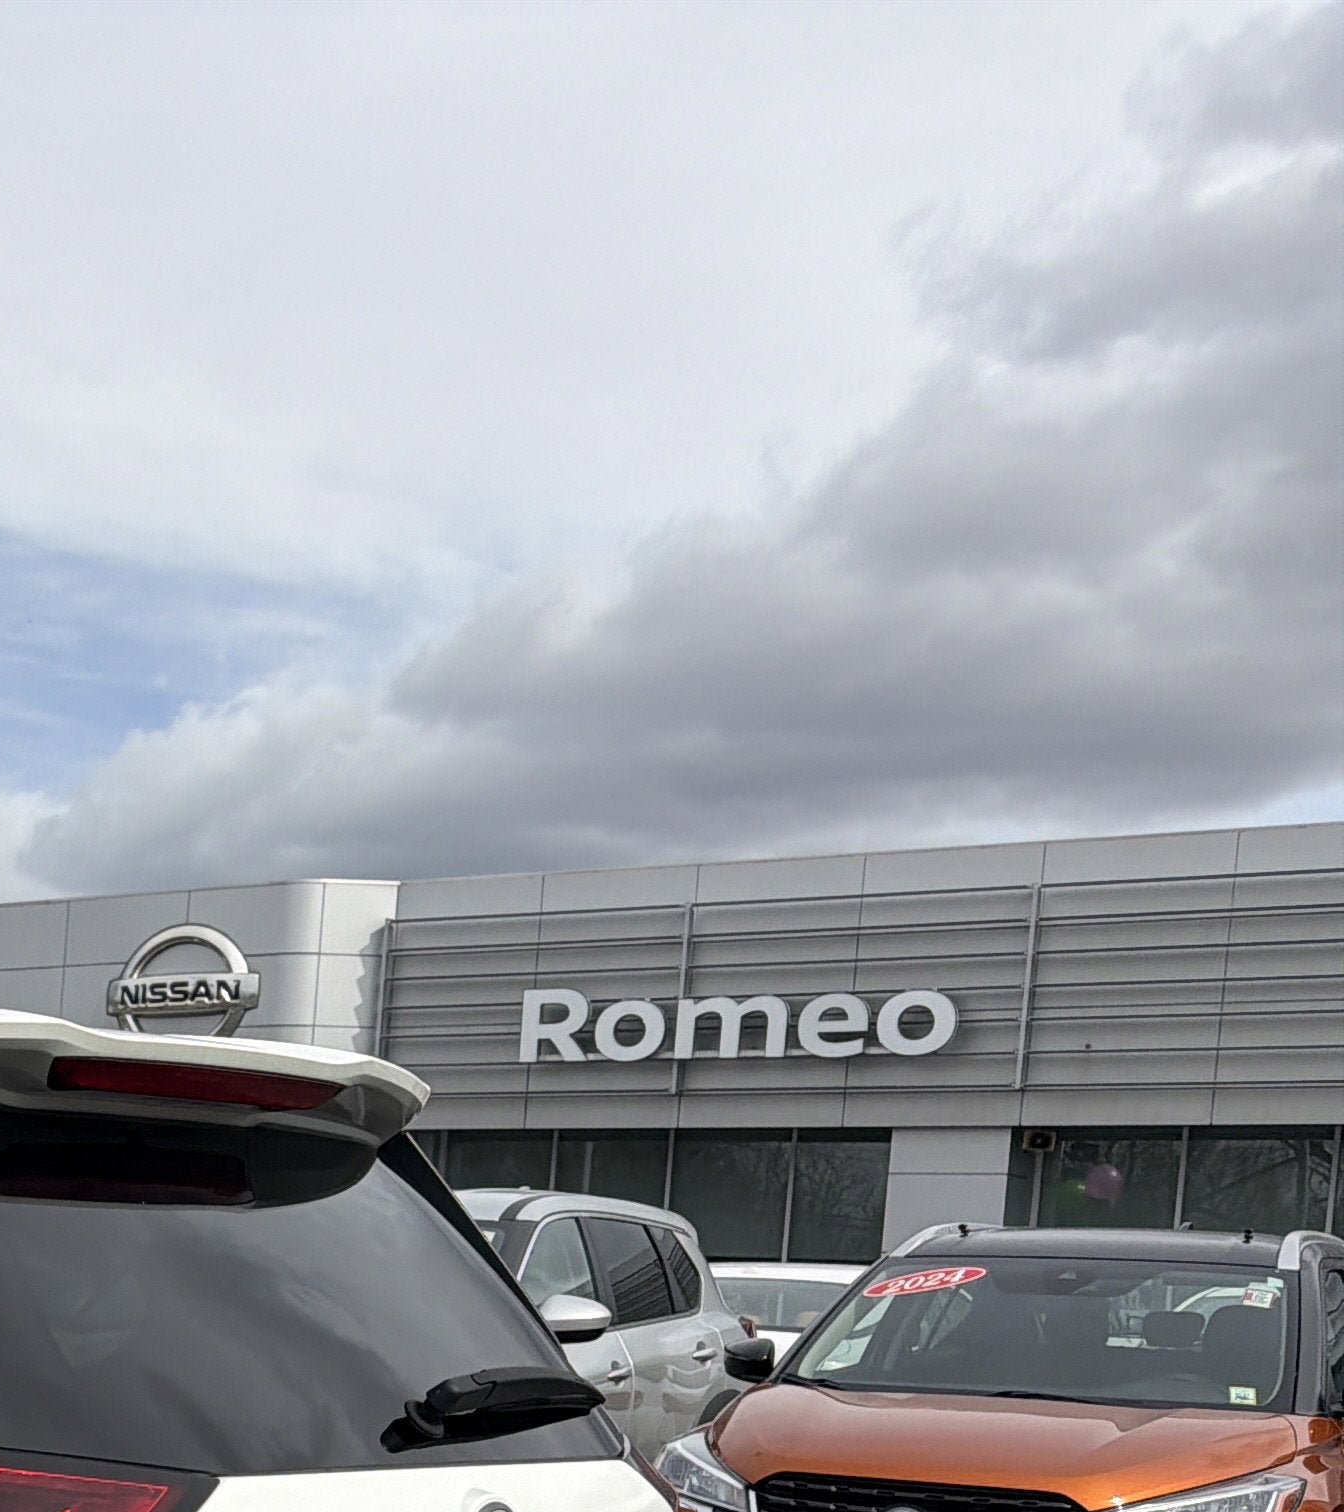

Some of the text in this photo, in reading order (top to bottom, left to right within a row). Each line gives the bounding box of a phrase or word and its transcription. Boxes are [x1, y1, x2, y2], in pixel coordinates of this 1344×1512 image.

[118, 979, 242, 1006] NISSAN
[518, 988, 960, 1063] Romeo
[881, 1267, 967, 1296] 2024
